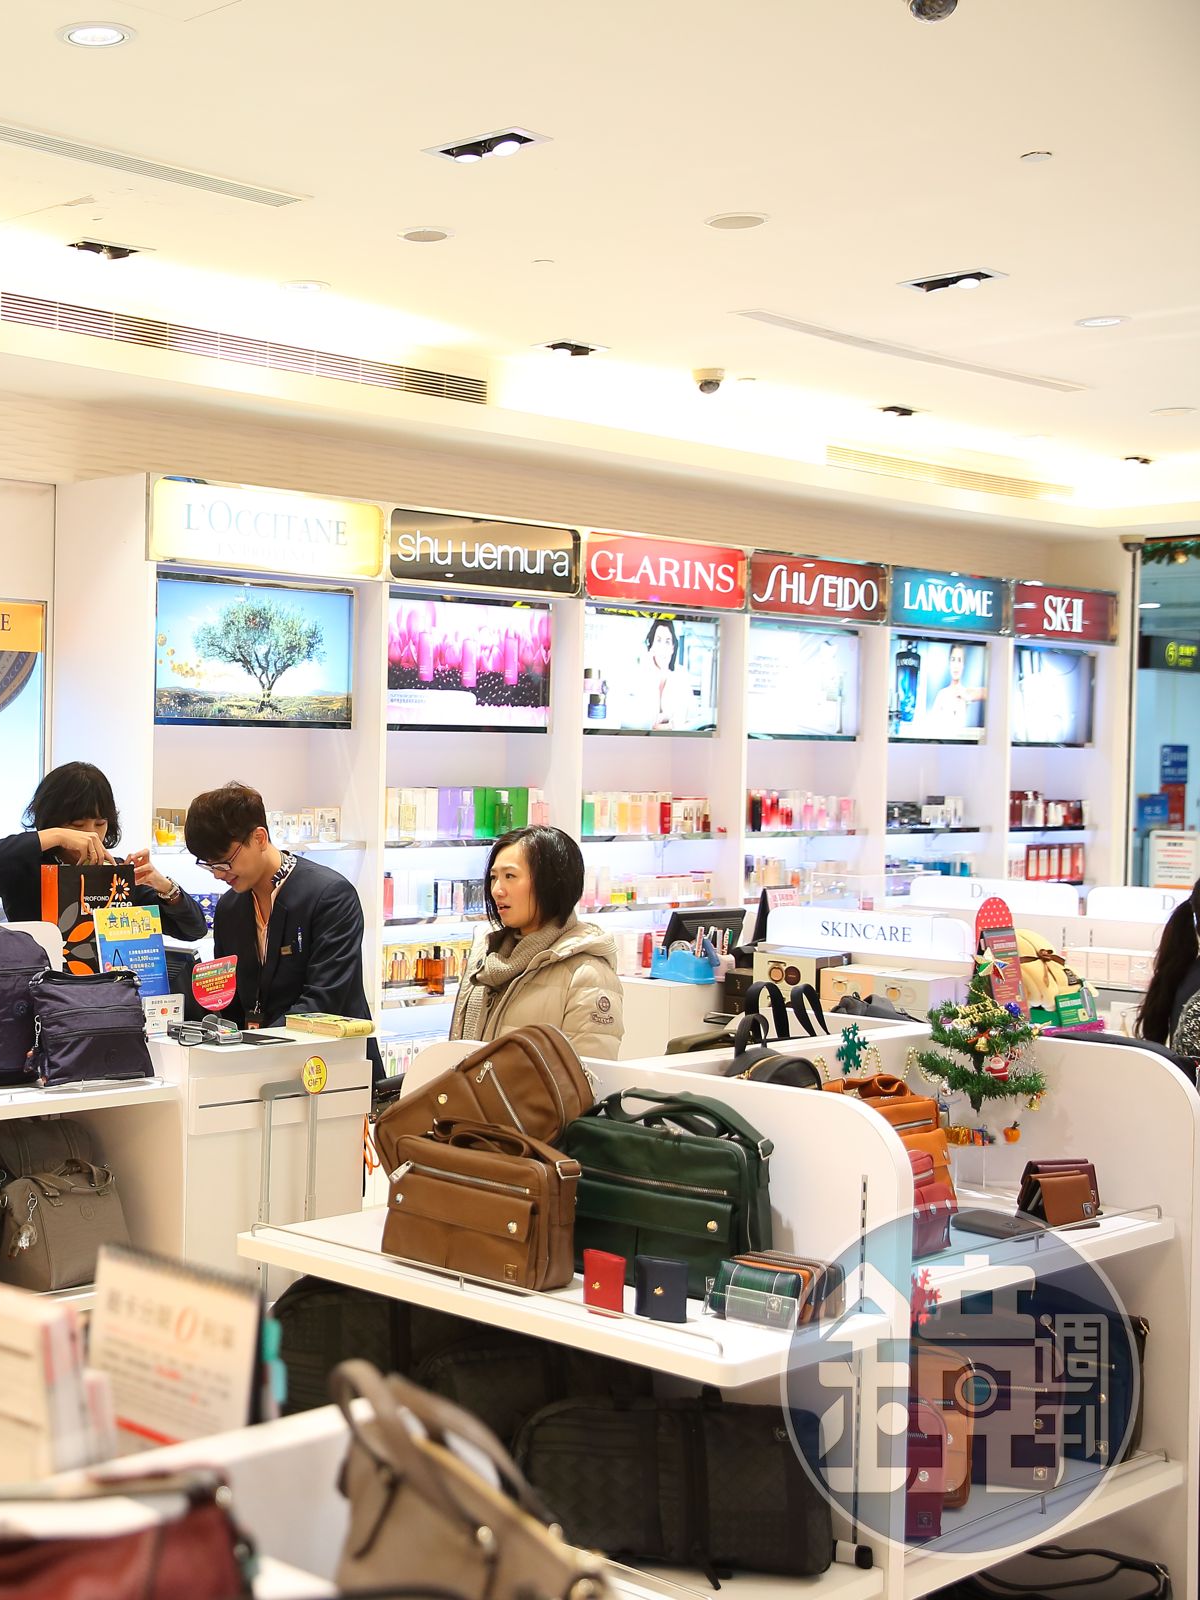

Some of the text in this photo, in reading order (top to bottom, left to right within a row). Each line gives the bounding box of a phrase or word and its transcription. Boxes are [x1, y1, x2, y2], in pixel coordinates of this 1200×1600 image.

[398, 530, 570, 577] shu uemura
[752, 564, 879, 612] SHISEIDO
[903, 581, 993, 618] LANCÔME
[821, 920, 913, 943] SKINCARE
[307, 1077, 323, 1087] GIFT
